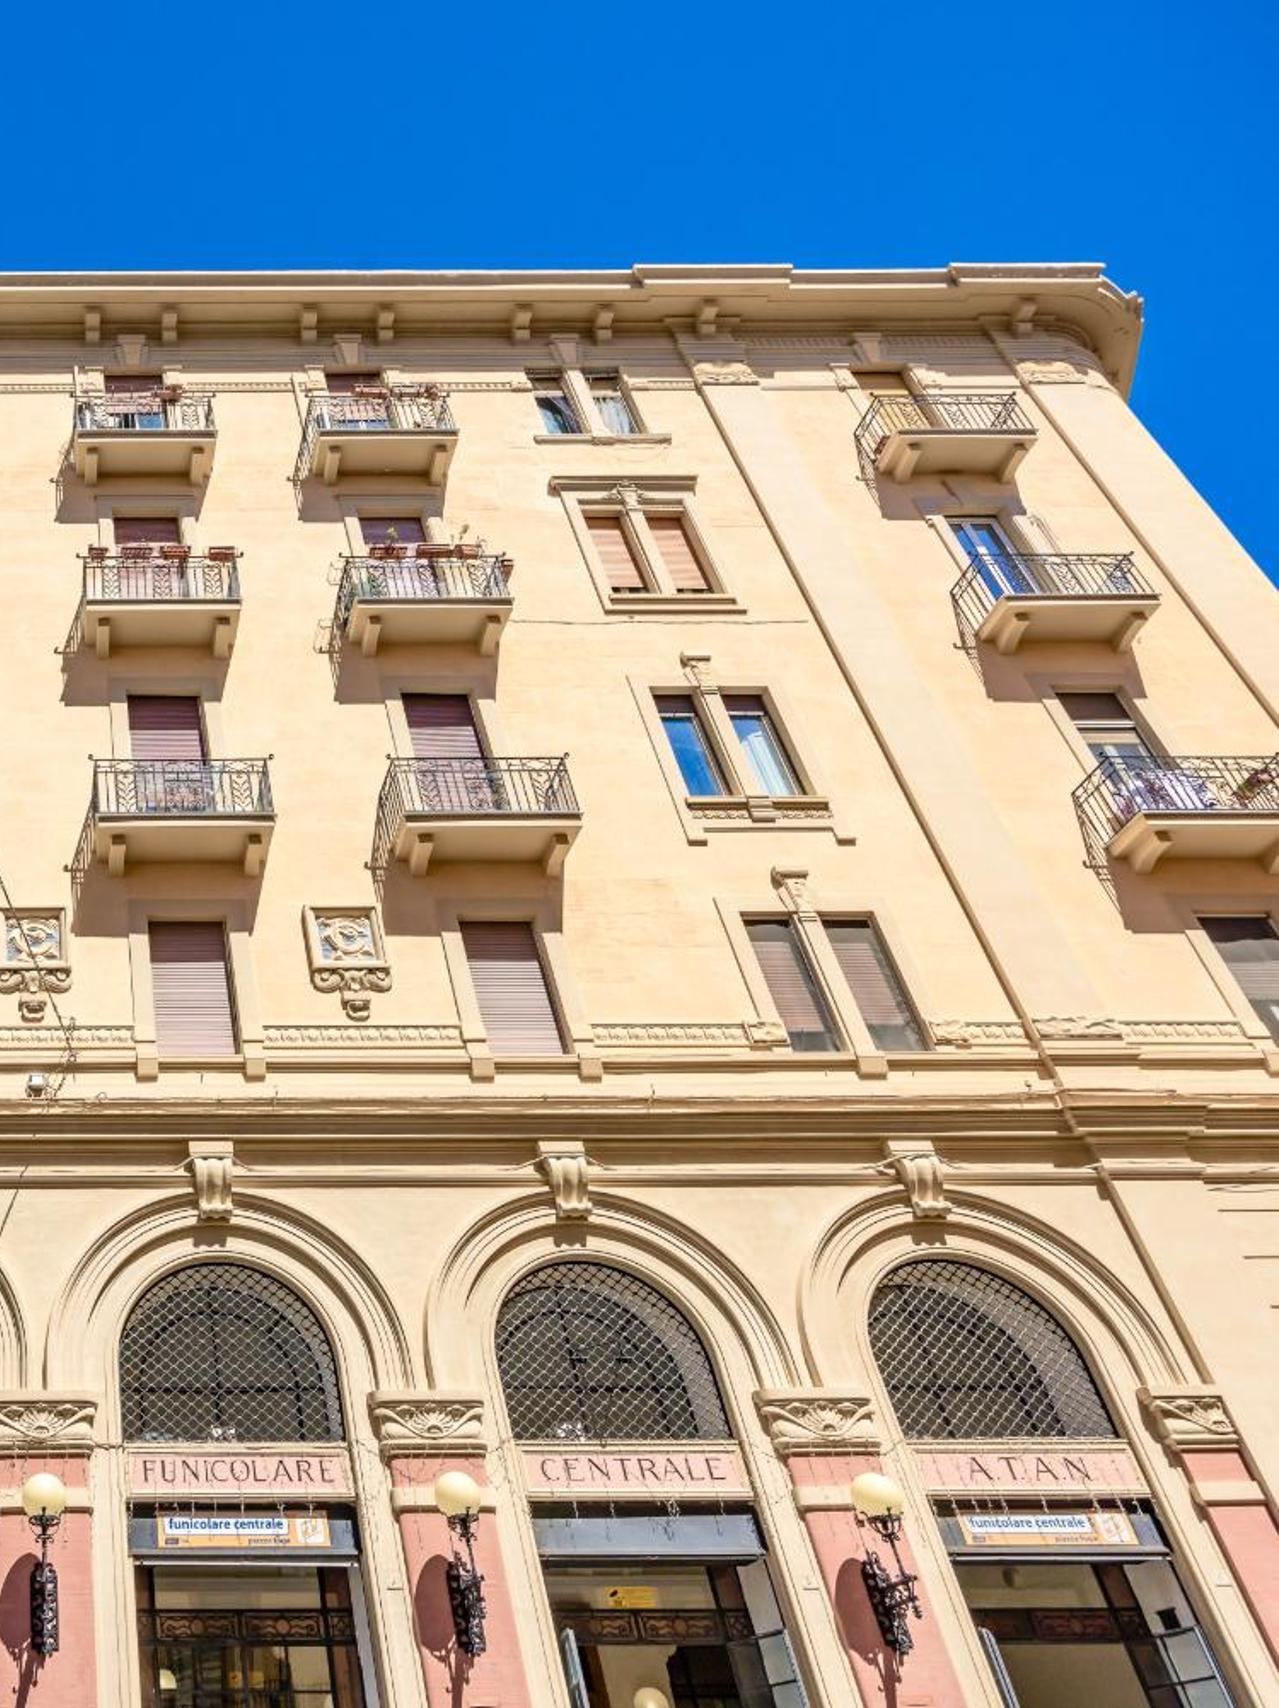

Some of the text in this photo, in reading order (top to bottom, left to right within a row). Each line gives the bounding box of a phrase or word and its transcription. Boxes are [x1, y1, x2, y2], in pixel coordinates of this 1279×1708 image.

[142, 1459, 336, 1484] FUNICOLARE
[540, 1457, 728, 1483] CENTRALE
[168, 1517, 284, 1531] funicolare centrale
[970, 1518, 1086, 1530] funicolare centrale
